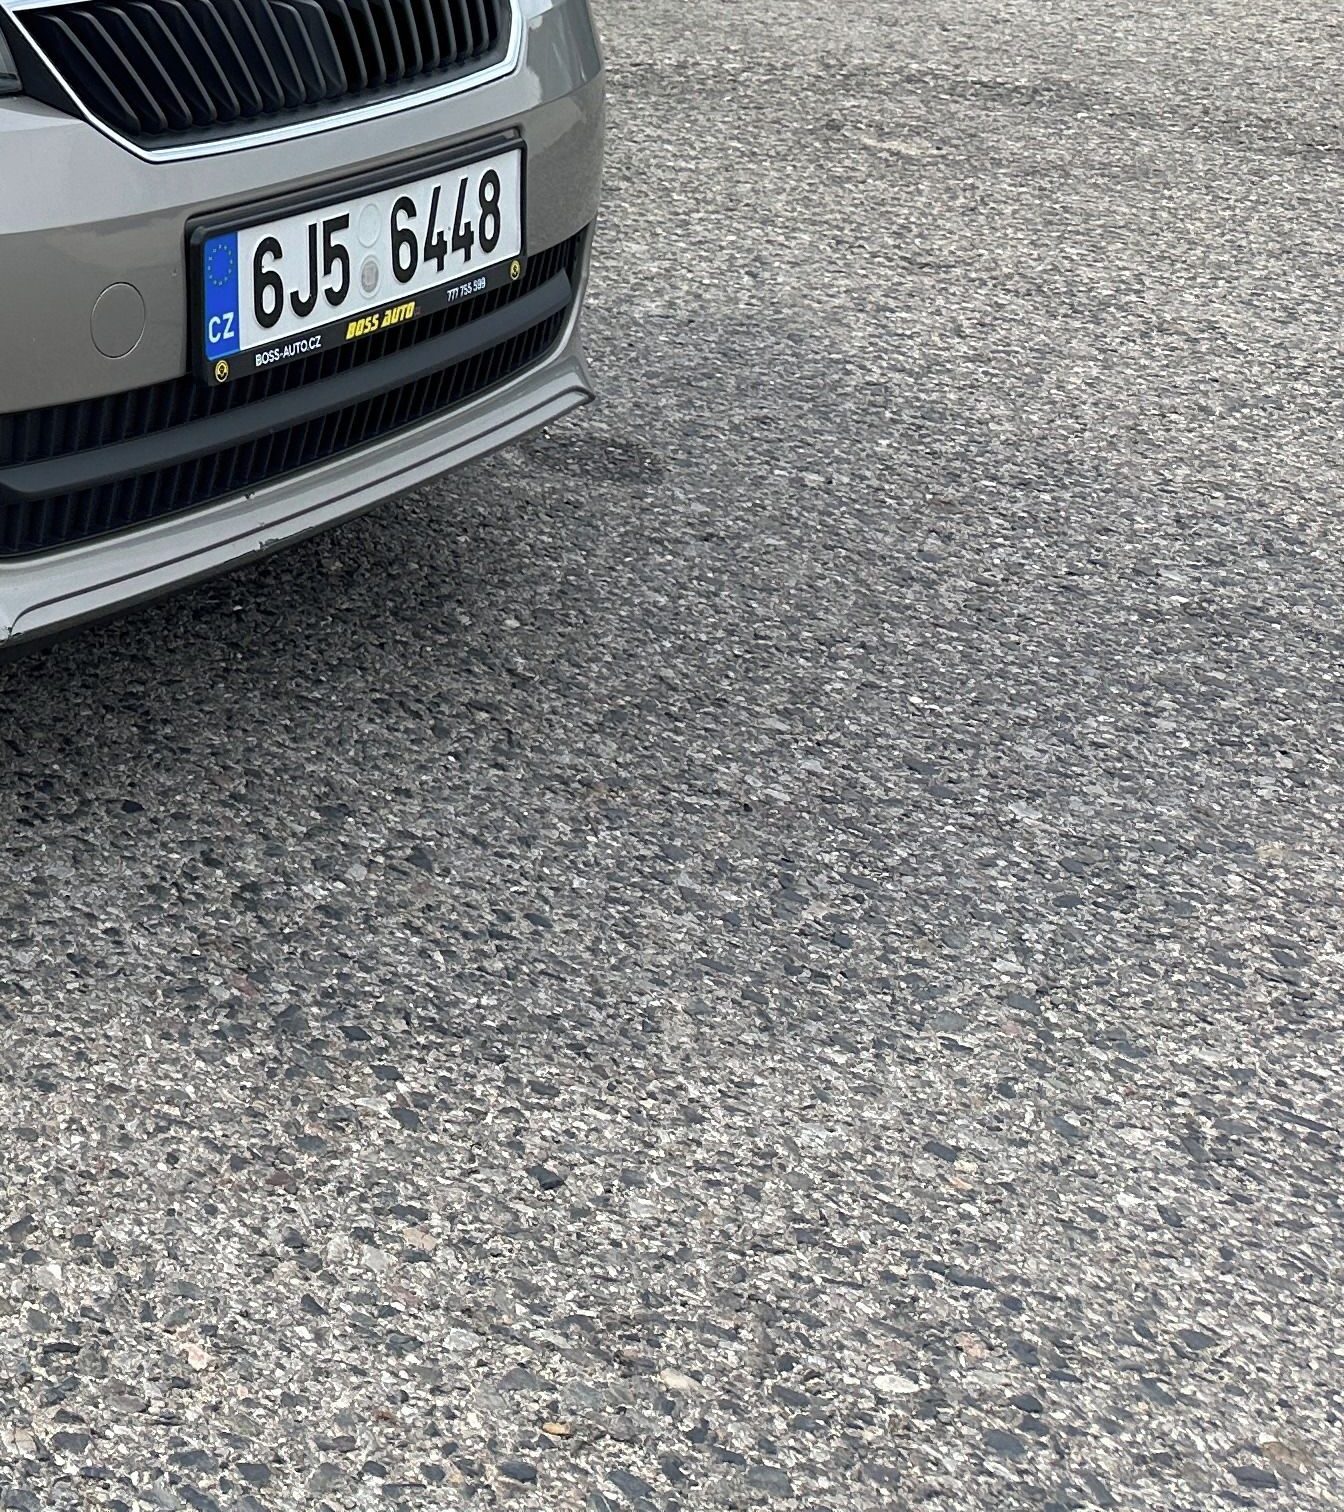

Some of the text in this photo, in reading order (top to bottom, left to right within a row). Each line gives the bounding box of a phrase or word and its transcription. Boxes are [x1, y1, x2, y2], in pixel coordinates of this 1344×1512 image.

[252, 169, 501, 328] 6J5 6448
[208, 312, 235, 343] CZ
[345, 313, 379, 340] BOSS
[380, 301, 416, 328] AUTO
[255, 334, 322, 367] BOSS-AUTO.CZ
